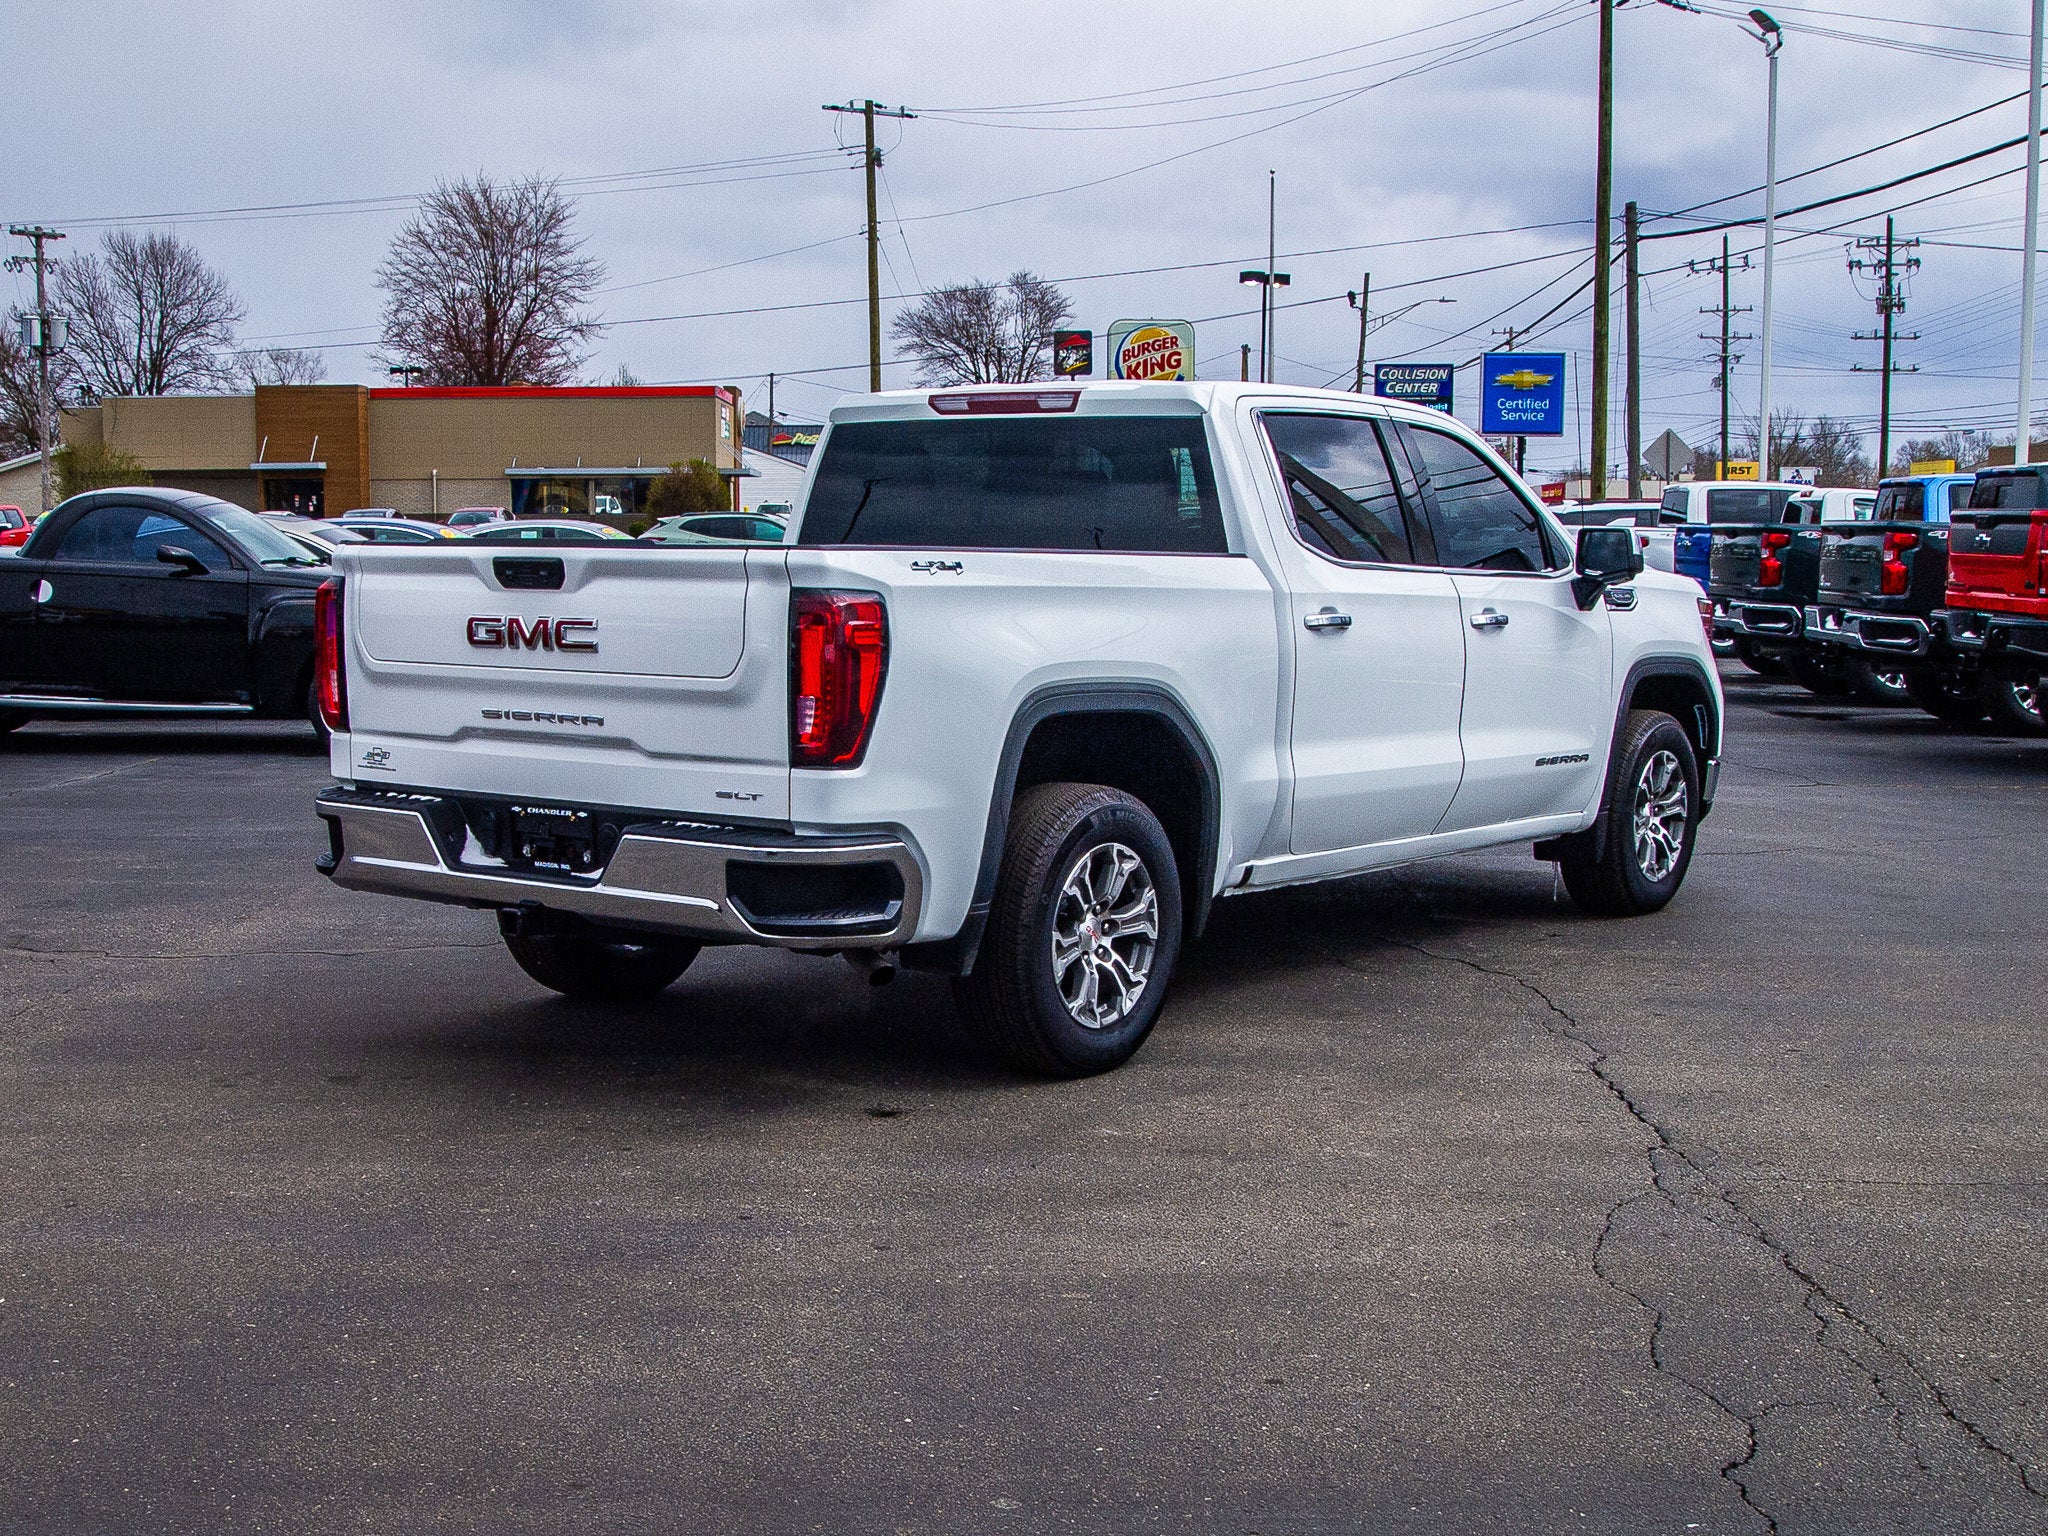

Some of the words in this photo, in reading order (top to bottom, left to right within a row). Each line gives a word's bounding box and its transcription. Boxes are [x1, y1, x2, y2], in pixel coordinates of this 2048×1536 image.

[1122, 335, 1179, 364] BURGER
[1126, 351, 1182, 380] KING
[1379, 367, 1448, 380] COLLISION
[1385, 381, 1439, 394] CENTER
[1497, 398, 1549, 410] Certified
[1501, 409, 1545, 421] Service
[791, 432, 820, 445] Pizz
[1726, 466, 1752, 477] IRST
[467, 614, 599, 653] GMC
[481, 708, 605, 727] SIERRA
[1535, 753, 1590, 767] SIERRA
[715, 789, 764, 801] SLT
[527, 807, 572, 817] CHANDLER
